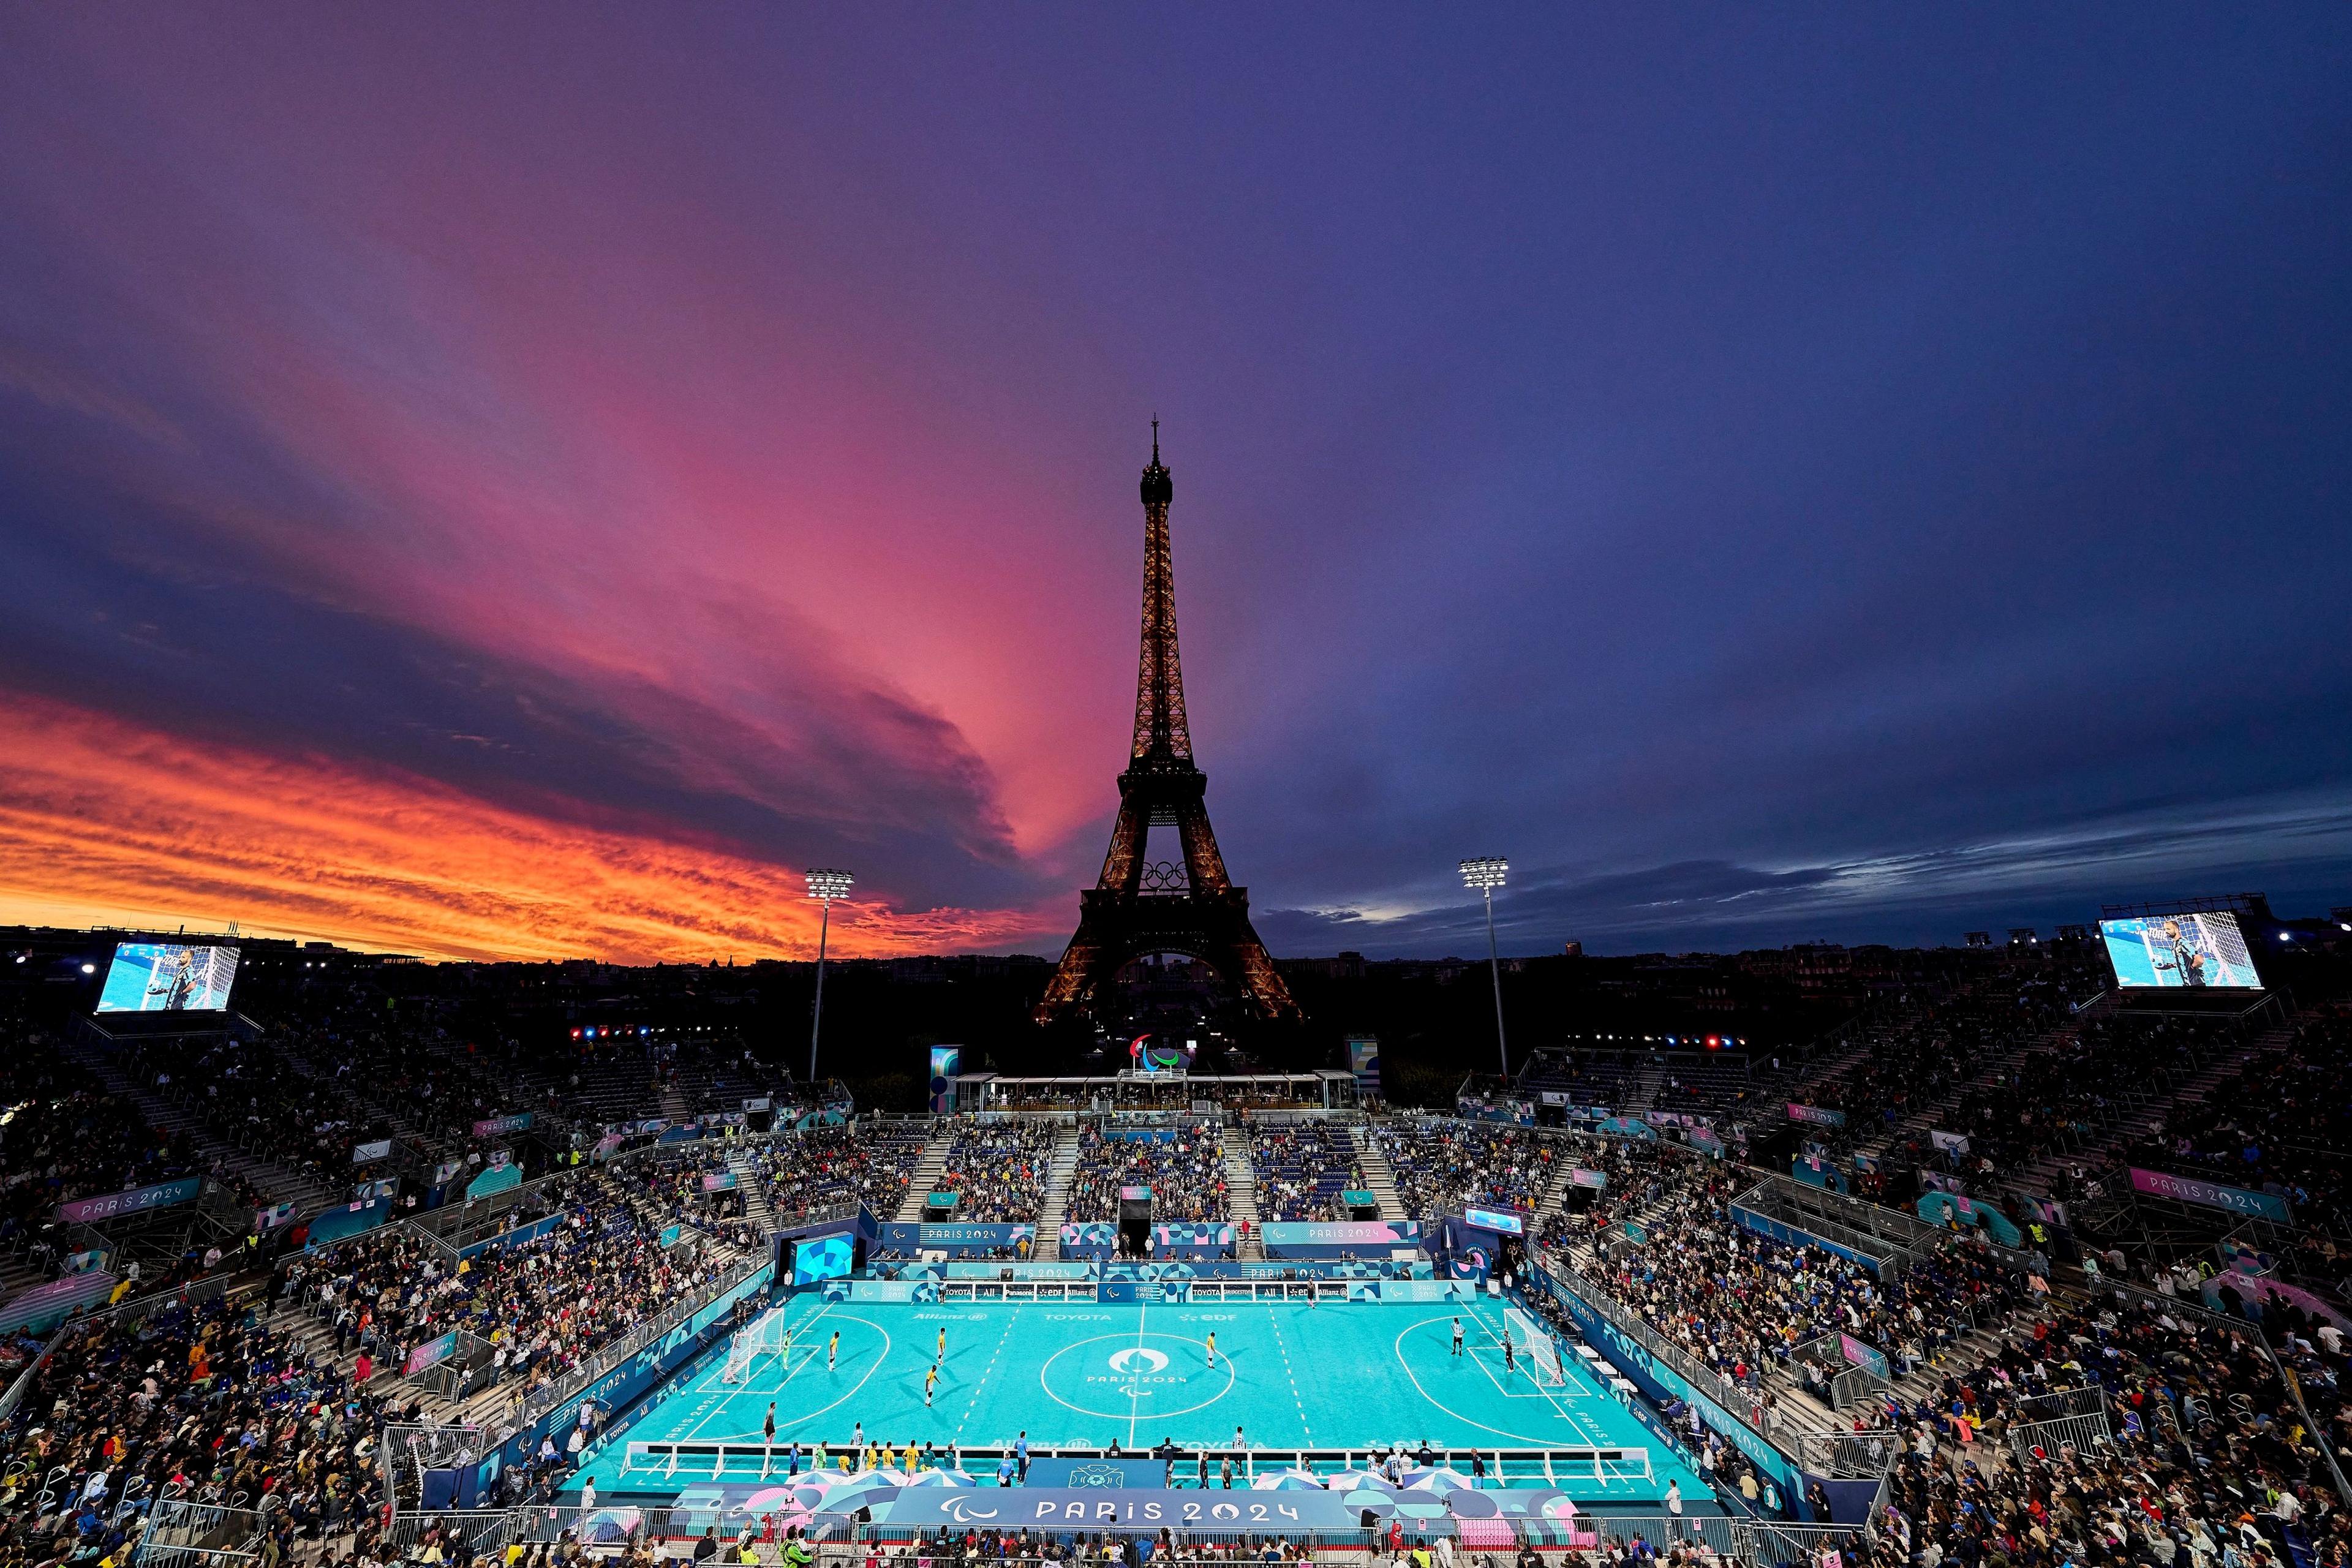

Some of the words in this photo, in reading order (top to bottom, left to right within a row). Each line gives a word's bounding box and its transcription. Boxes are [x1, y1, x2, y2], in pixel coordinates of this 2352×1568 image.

[506, 1118, 524, 1127] 2024
[138, 1187, 181, 1204] 2024
[2207, 1190, 2261, 1211] 2024
[967, 1230, 996, 1238] 2024
[1348, 1229, 1378, 1237] 2024
[1039, 1269, 1069, 1278] 2024
[1295, 1269, 1323, 1278] 024
[983, 1289, 995, 1297] All
[1264, 1289, 1276, 1297] All
[1577, 1303, 1595, 1325] 2024
[600, 1371, 626, 1397] 2024
[610, 1421, 630, 1439] TOYOTA
[1735, 1428, 1768, 1464] 2024
[1182, 1502, 1298, 1521] 2024
